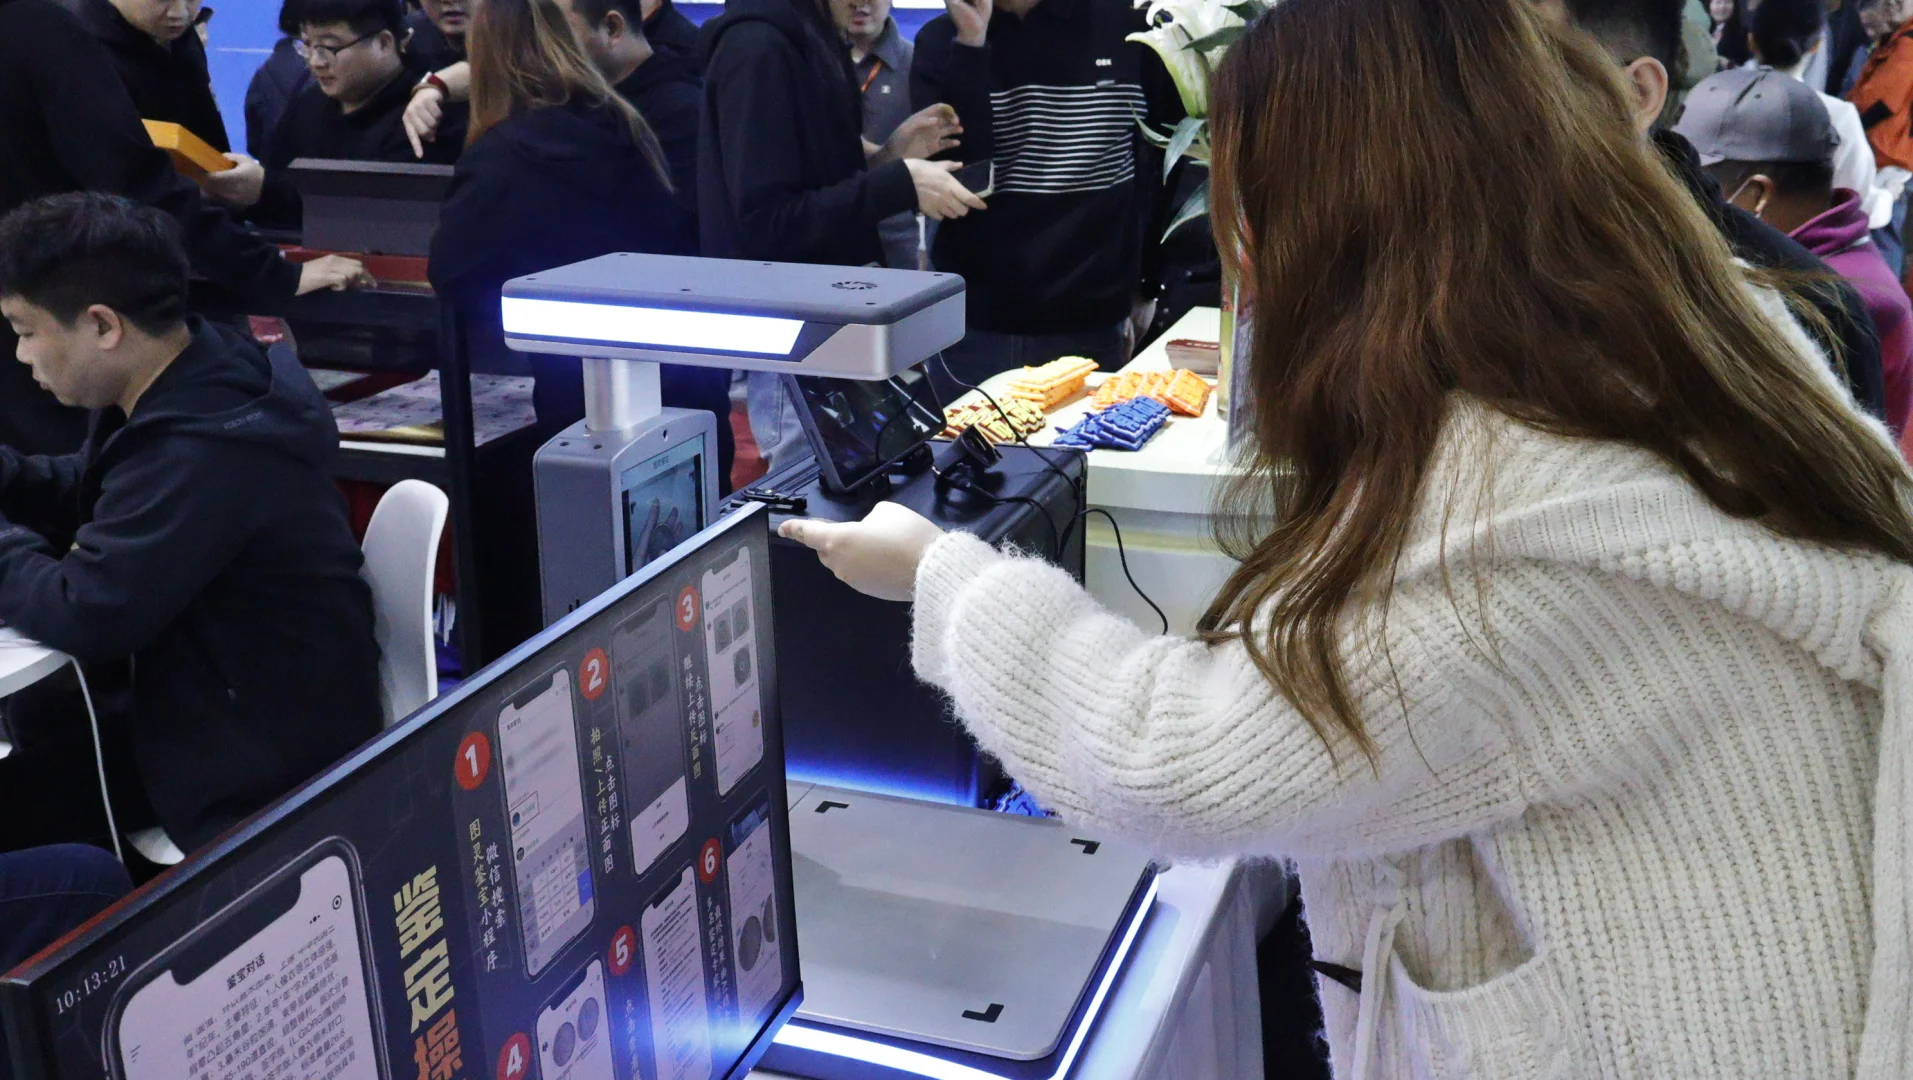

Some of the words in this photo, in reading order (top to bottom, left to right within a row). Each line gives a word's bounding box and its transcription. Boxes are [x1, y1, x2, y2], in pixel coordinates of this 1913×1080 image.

[682, 593, 694, 623] 3
[587, 658, 602, 692] 2
[465, 746, 482, 777] 1
[604, 754, 621, 831] 点击图标
[704, 846, 716, 875] 6
[468, 818, 498, 973] 图灵鉴宝小程序
[485, 842, 506, 929] 微信搜索
[615, 934, 629, 966] 5
[54, 954, 127, 1015] 10:13:21
[227, 953, 265, 991] 鉴宝对话
[506, 1043, 523, 1078] 4
